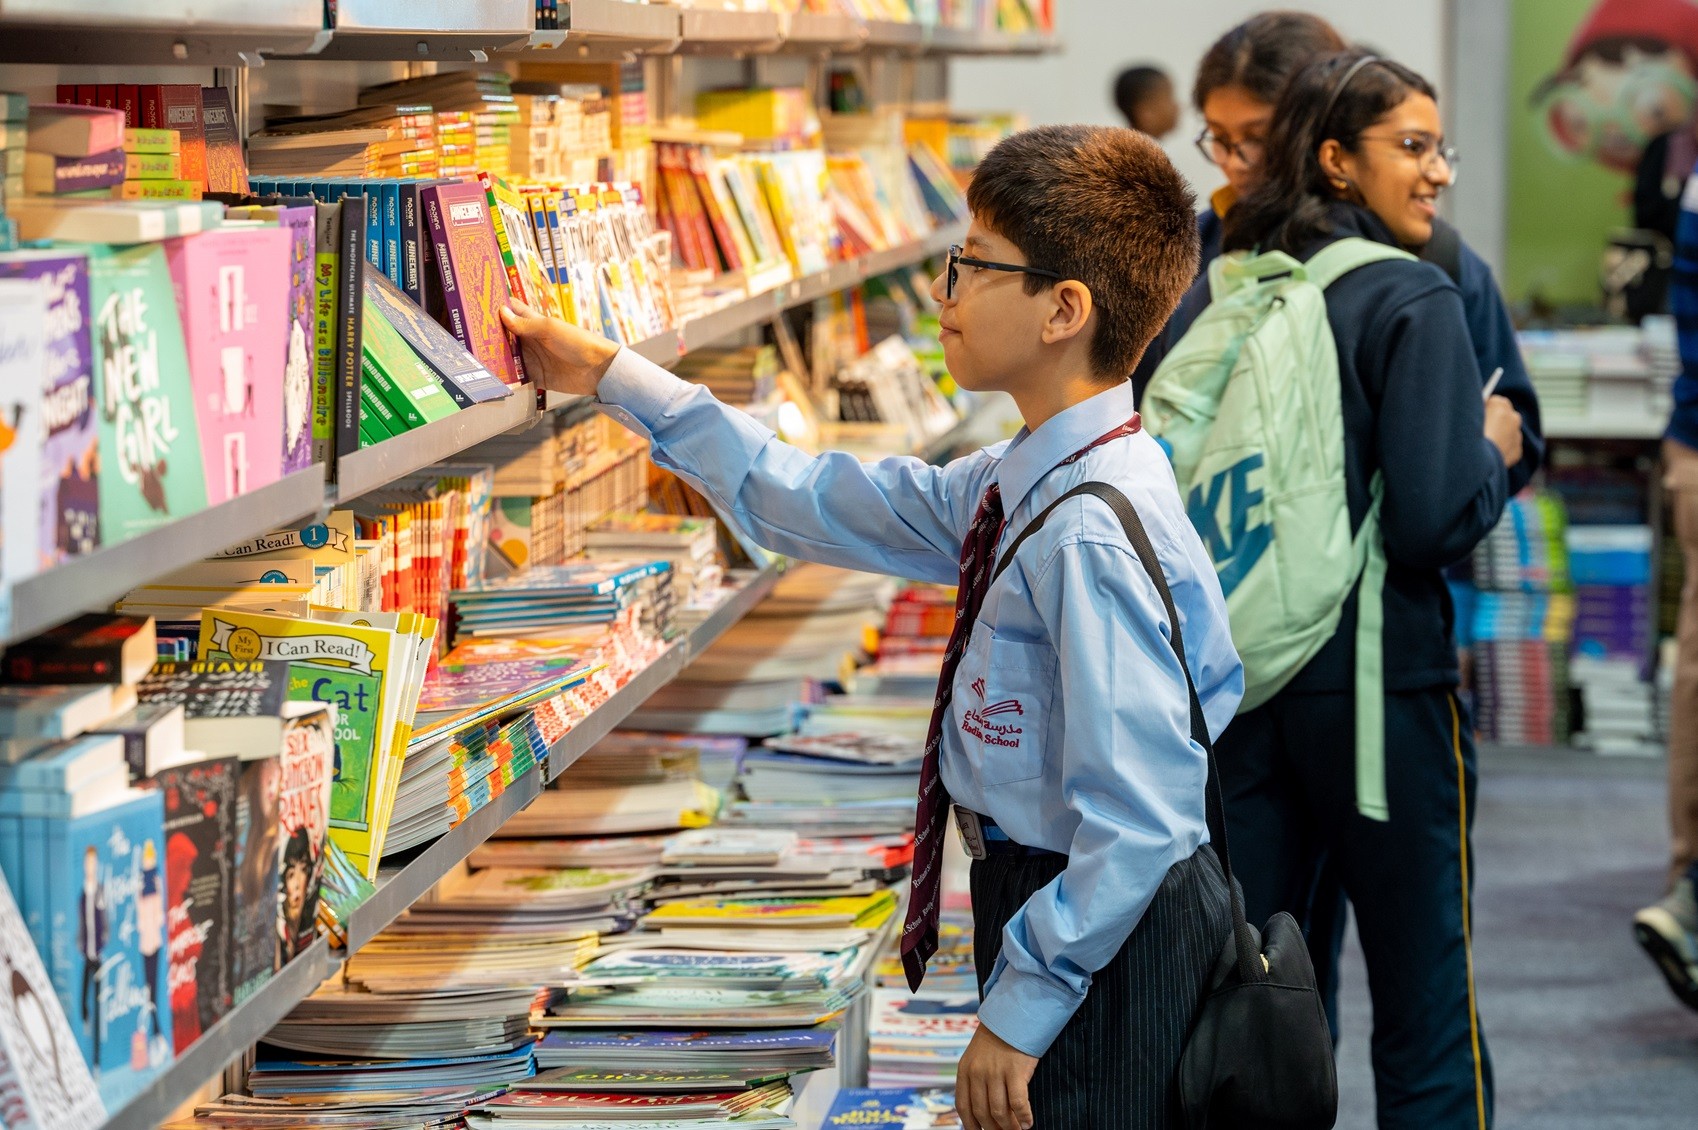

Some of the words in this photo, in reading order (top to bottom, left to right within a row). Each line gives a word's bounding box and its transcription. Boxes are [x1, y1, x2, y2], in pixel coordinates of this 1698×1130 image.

[406, 197, 414, 227] MOJANG
[316, 263, 333, 286] My
[349, 243, 357, 282] UNOFFICIAL
[388, 239, 398, 286] MINECRAF
[405, 239, 418, 291] MINECRAFT
[429, 201, 441, 230] MOJANG
[436, 242, 456, 292] MINECRAFT
[451, 308, 464, 339] COMBAT
[97, 287, 148, 344] THE
[319, 289, 332, 316] Life
[318, 320, 327, 334] as
[318, 336, 327, 345] a
[346, 317, 355, 349] HARRY
[104, 329, 160, 414] NEW
[345, 351, 354, 388] POTTER
[316, 348, 332, 426] Billionaire
[344, 390, 352, 428] SPELLBOOK
[115, 394, 179, 484] GIRL
[1187, 452, 1264, 563] KE
[254, 534, 295, 551] Read!
[310, 527, 318, 541] 1
[234, 644, 254, 654] First
[238, 636, 252, 645] My
[267, 641, 273, 655] I
[276, 641, 310, 656] Can
[314, 639, 361, 659] Read!
[311, 677, 369, 713] Cat
[334, 728, 361, 741] OOL
[984, 734, 1020, 748] School
